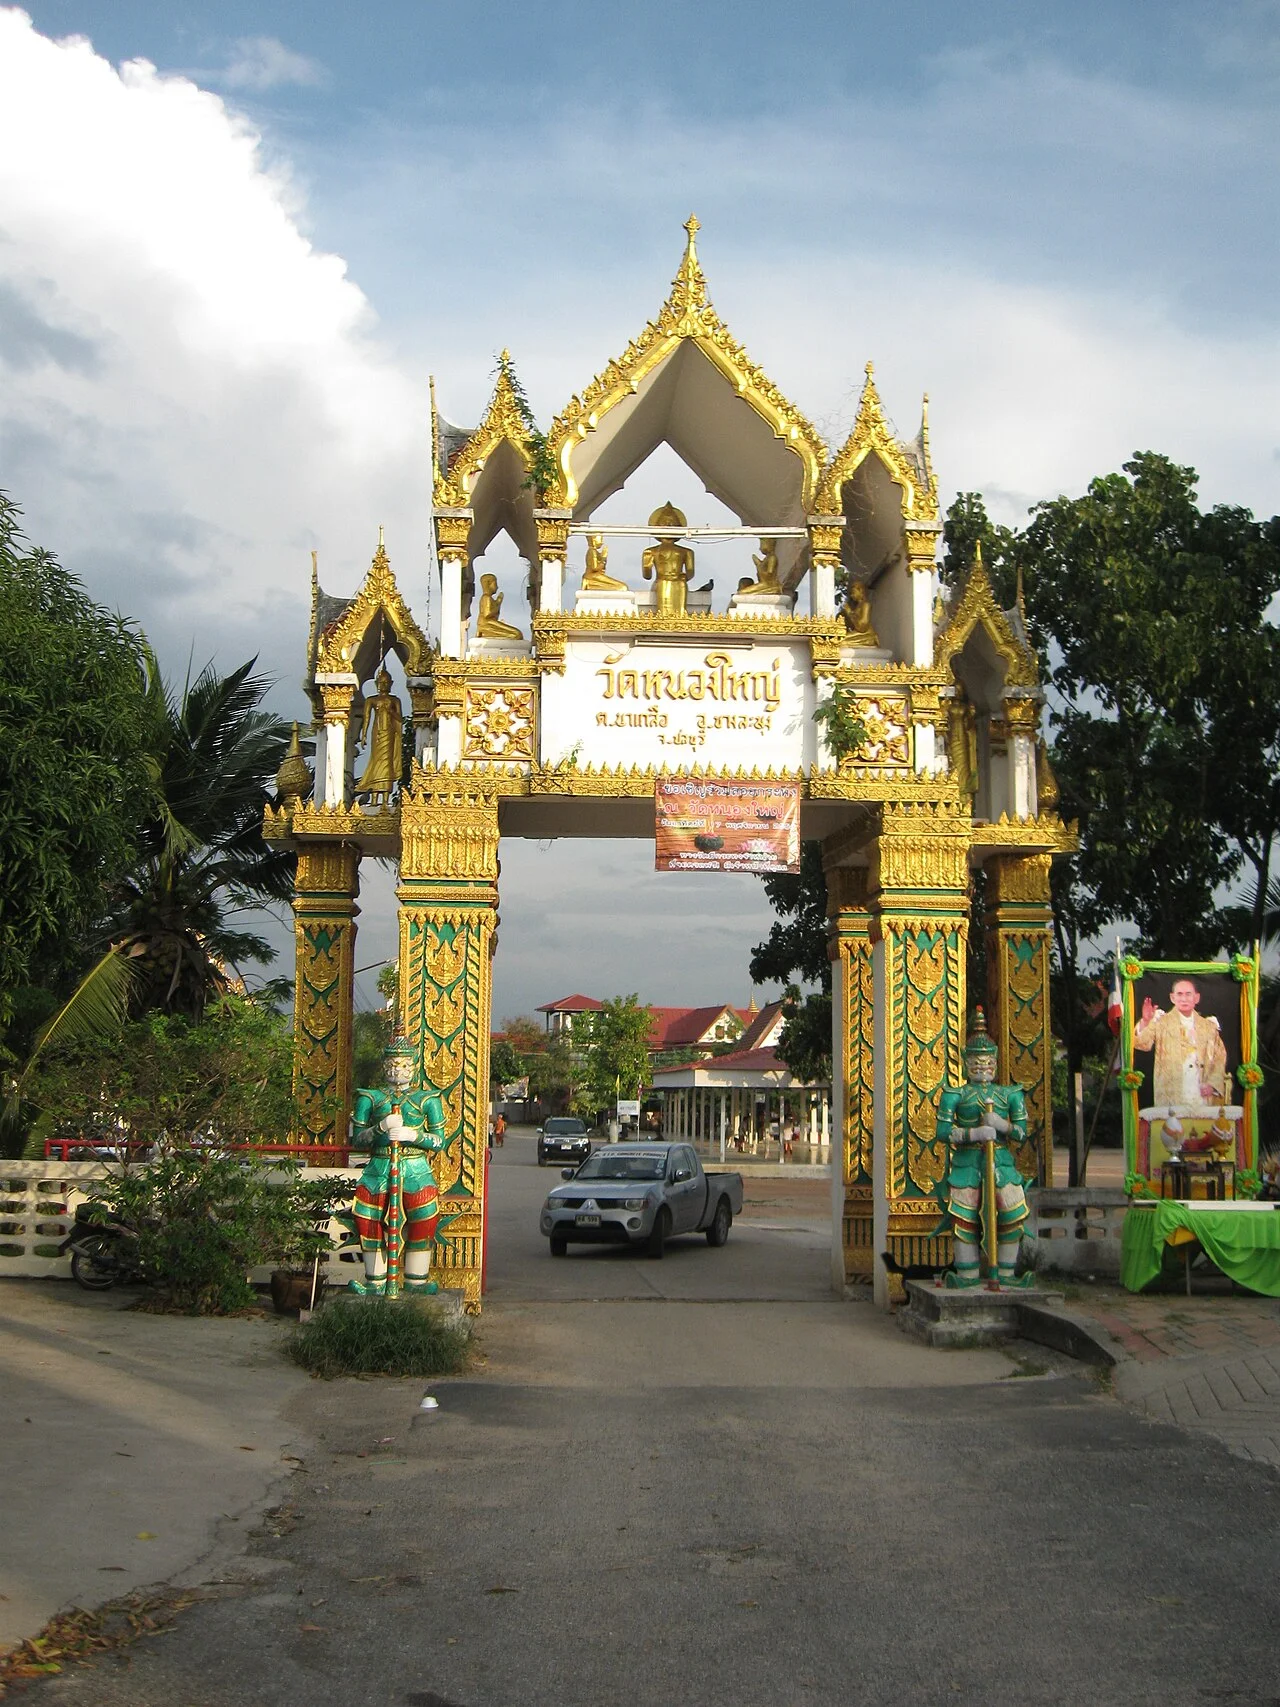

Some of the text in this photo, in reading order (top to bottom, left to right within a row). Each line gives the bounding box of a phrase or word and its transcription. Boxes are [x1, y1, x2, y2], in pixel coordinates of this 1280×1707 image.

[596, 652, 781, 712] วัดหนองใหญ่
[688, 799, 785, 819] วัดหนองใหญ่
